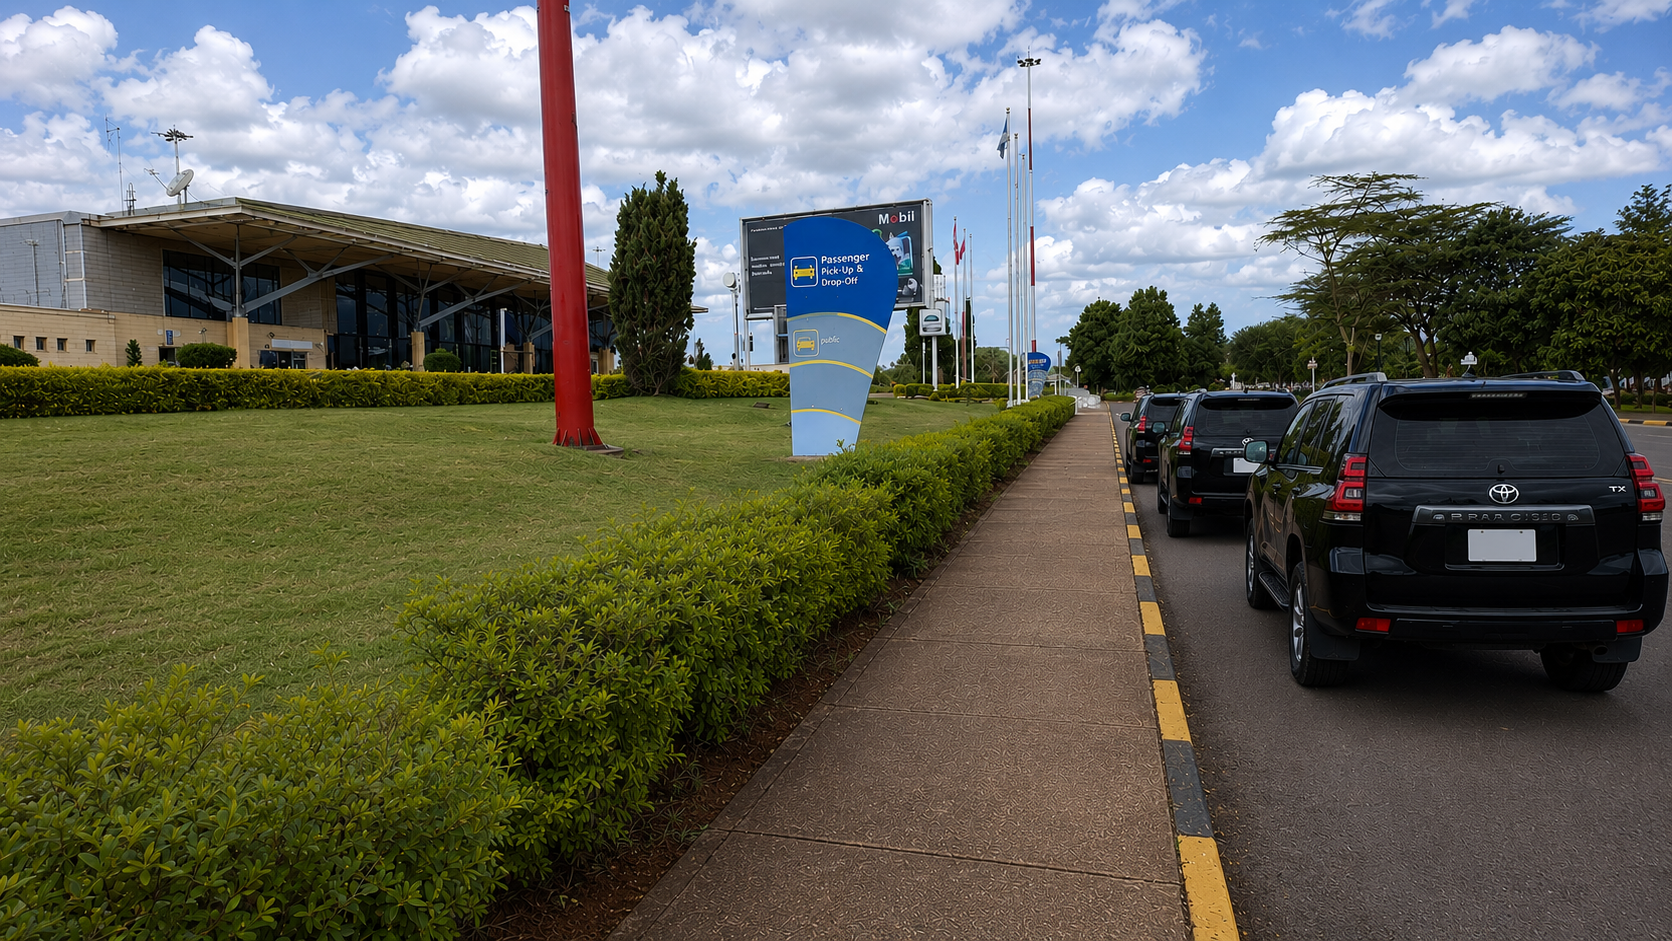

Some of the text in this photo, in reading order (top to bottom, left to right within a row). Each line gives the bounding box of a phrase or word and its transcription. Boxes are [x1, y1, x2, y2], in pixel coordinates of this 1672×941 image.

[879, 211, 915, 225] Mobil
[821, 253, 870, 265] Passenger
[821, 264, 864, 275] Pick-Up &
[821, 276, 859, 287] Drop-Off
[1608, 485, 1627, 493] TX
